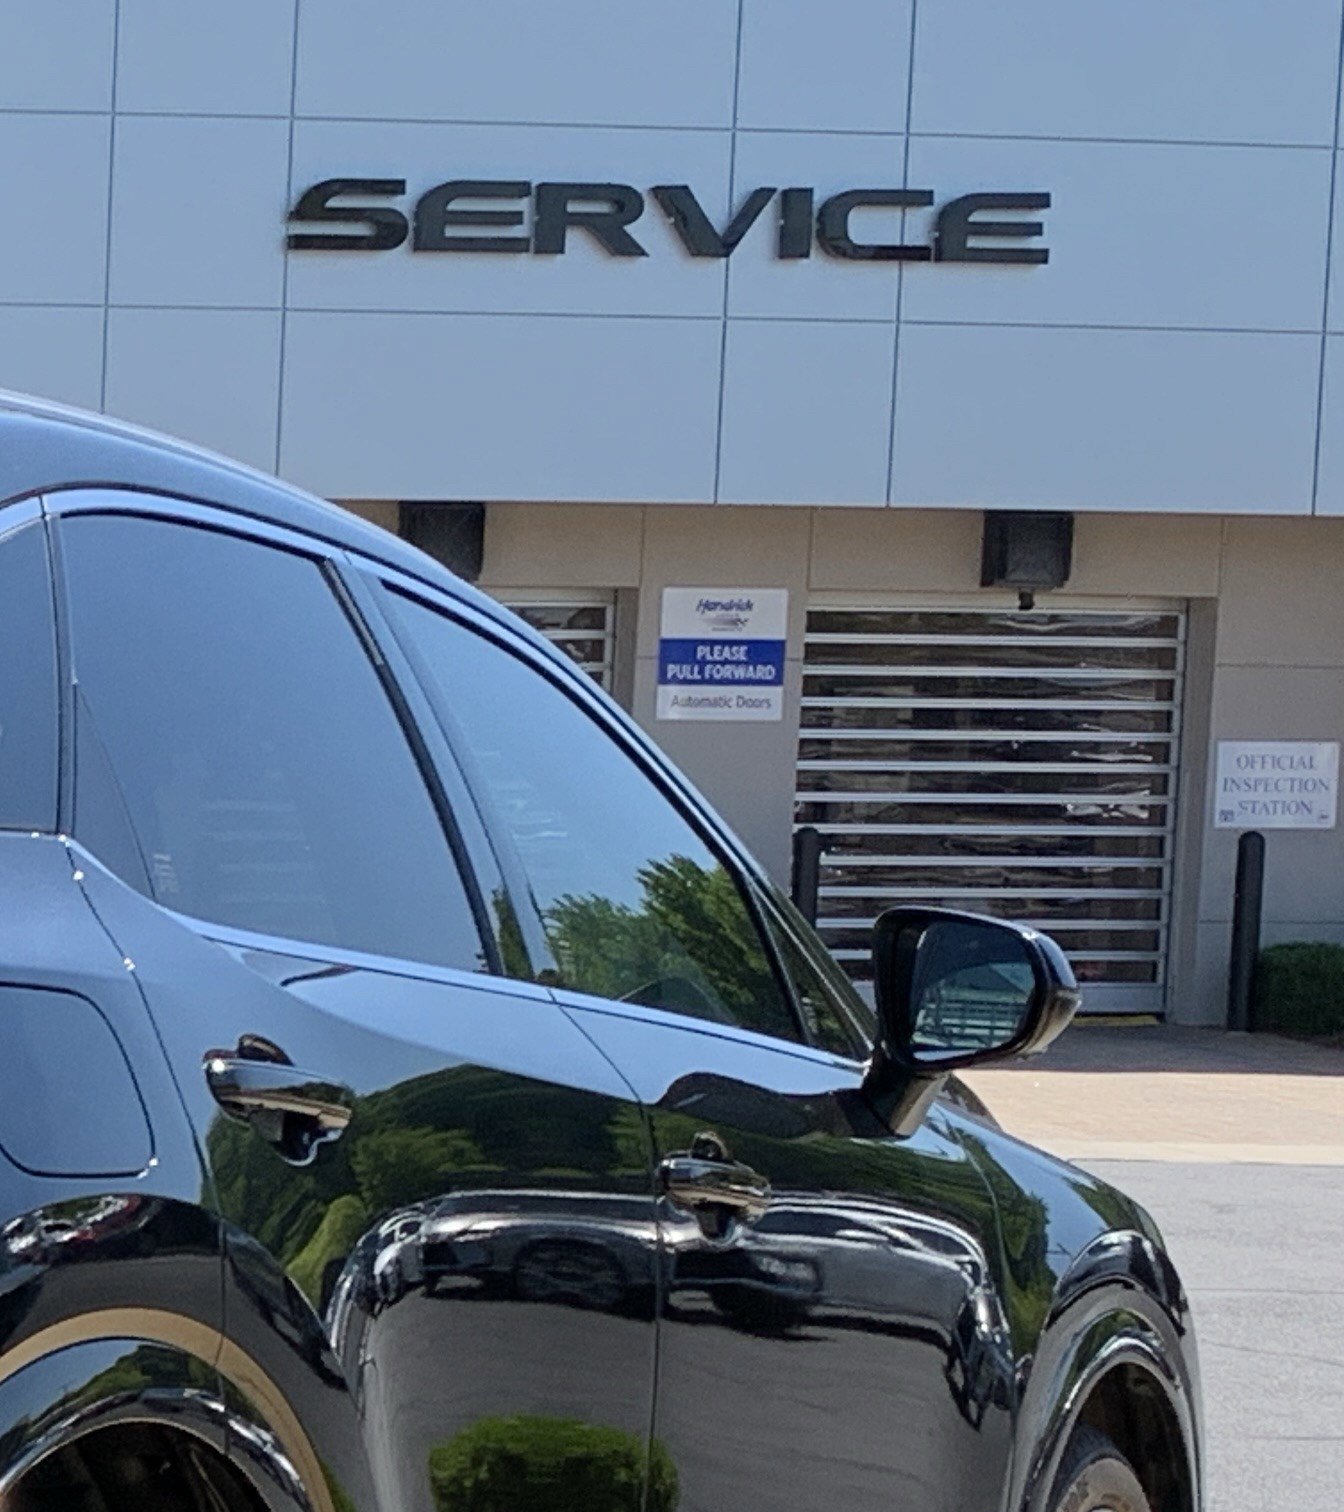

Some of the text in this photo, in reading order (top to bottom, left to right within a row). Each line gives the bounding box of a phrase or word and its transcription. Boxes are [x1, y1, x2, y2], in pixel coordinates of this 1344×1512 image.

[285, 177, 1051, 265] SERVICE
[695, 598, 754, 614] Hendrick
[696, 645, 748, 661] PLEASE
[666, 664, 777, 680] PULL FORWARD
[670, 695, 772, 708] Automatic Doors
[1235, 753, 1316, 771] OFFICIAL
[1223, 777, 1330, 793] INSPECTION
[1237, 800, 1313, 816] STATION
